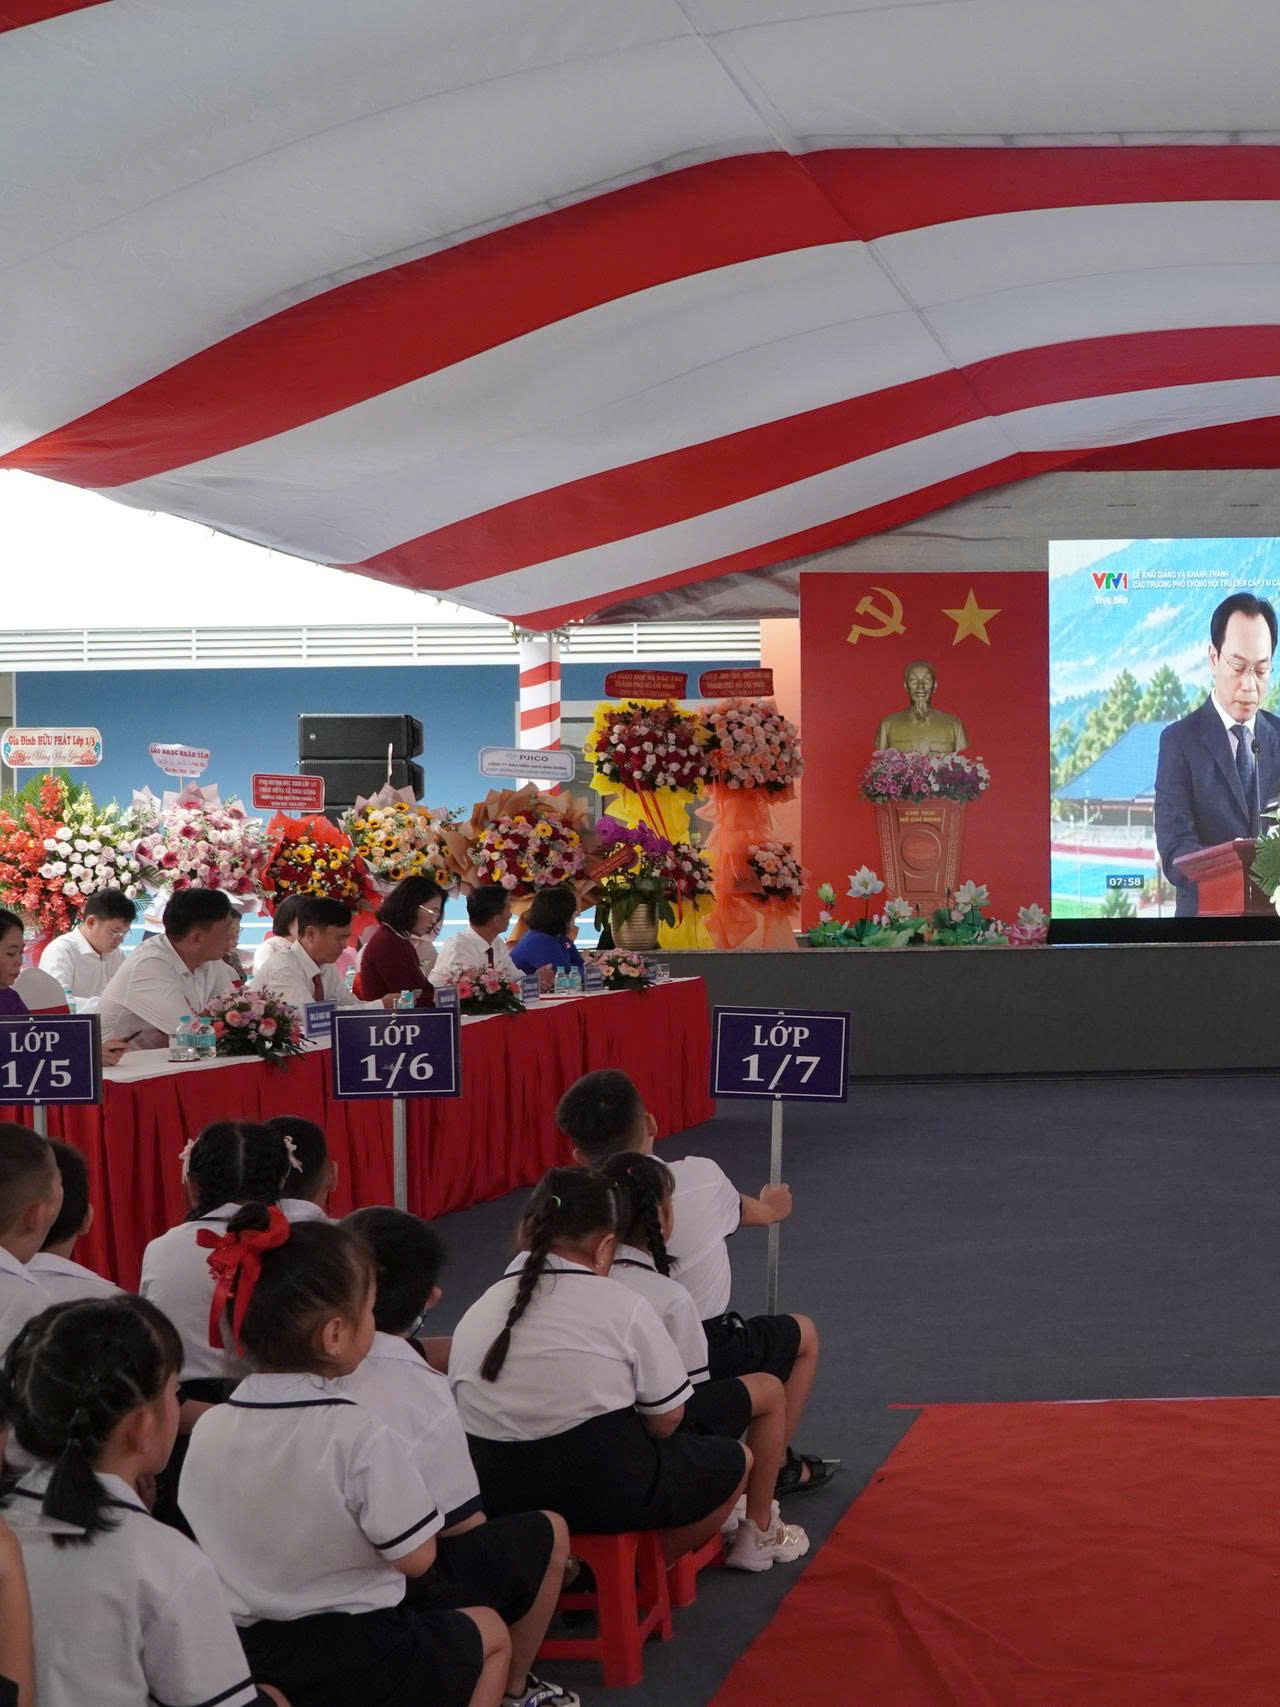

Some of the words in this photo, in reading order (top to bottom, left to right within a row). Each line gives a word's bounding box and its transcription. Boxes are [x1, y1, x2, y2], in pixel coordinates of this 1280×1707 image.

[1092, 572, 1128, 590] VTV1
[38, 734, 52, 745] HỮU
[54, 733, 70, 745] PHÁT
[520, 754, 549, 762] PJICO
[1109, 877, 1142, 886] 07:58
[10, 1026, 60, 1052] LỚP
[369, 1020, 420, 1046] LỚP
[753, 1020, 809, 1047] LỚP
[1, 1059, 72, 1095] 1/5
[360, 1053, 434, 1088] 1/6
[742, 1054, 820, 1090] 1/7
